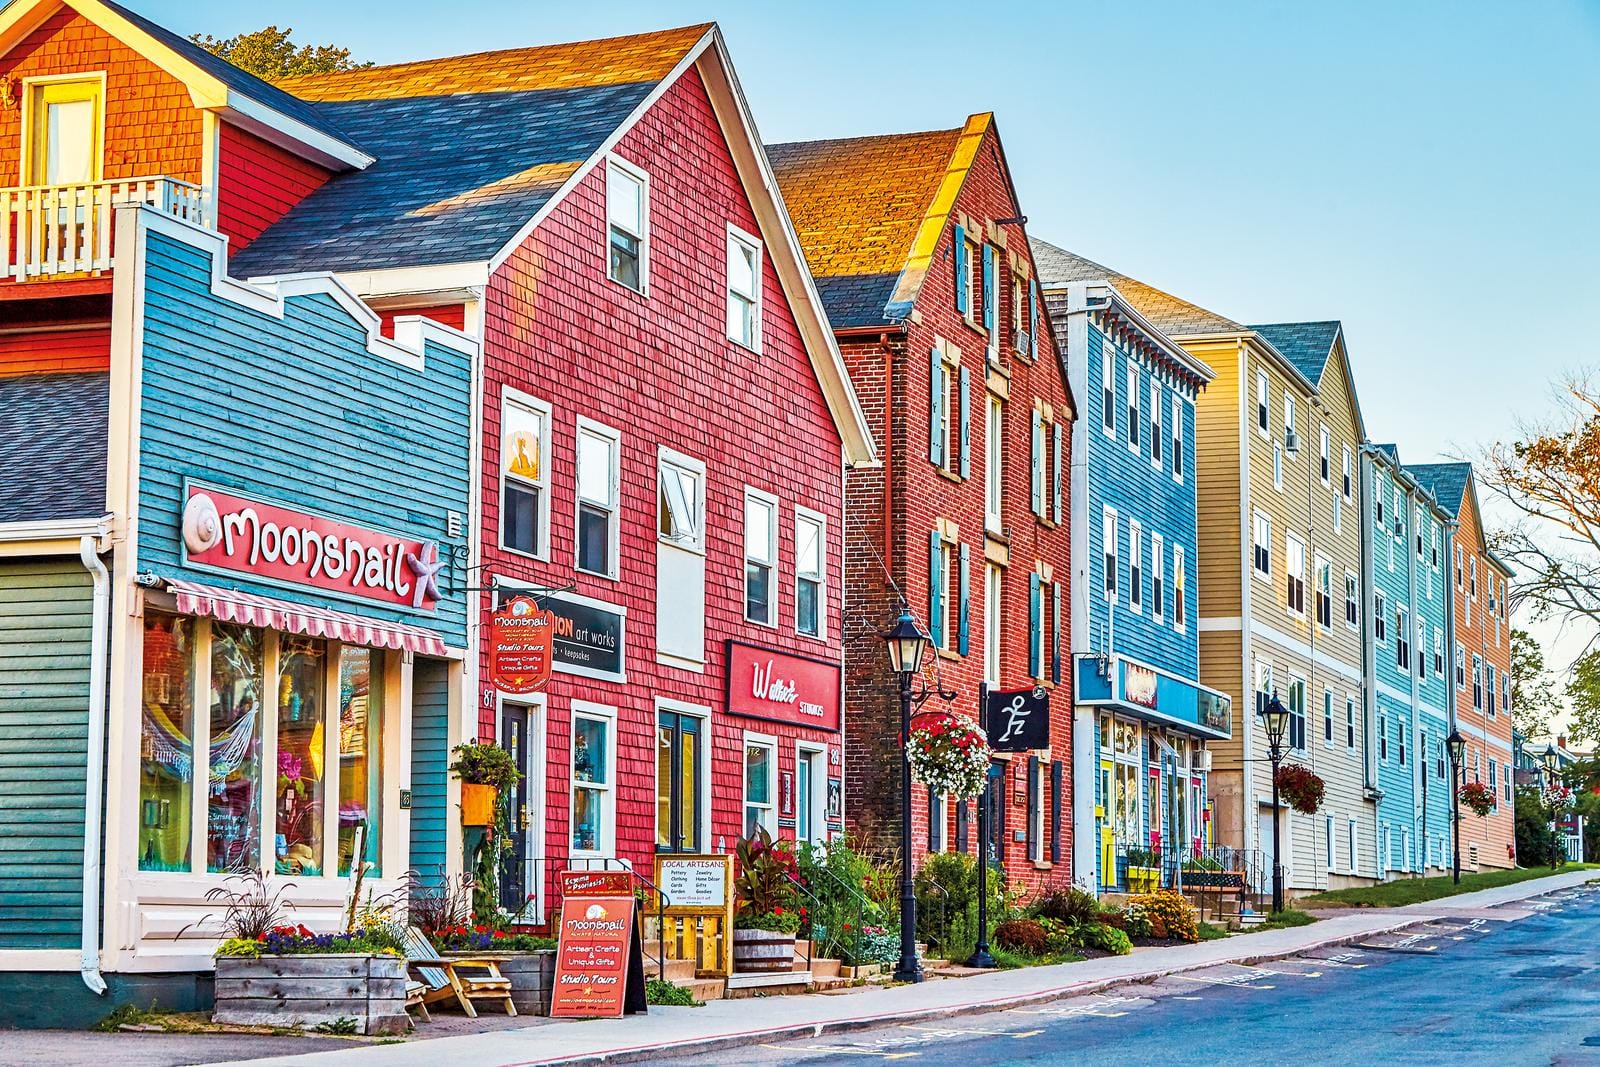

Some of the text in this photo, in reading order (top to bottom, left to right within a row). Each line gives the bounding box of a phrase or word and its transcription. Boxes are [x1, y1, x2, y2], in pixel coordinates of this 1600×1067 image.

[554, 617, 615, 648] ION art works
[498, 643, 521, 651] Studio
[524, 643, 544, 651] Tours
[565, 648, 590, 661] keepsakes
[483, 690, 493, 708] 87
[569, 959, 595, 967] Unique
[561, 974, 618, 985] Studio Tours
